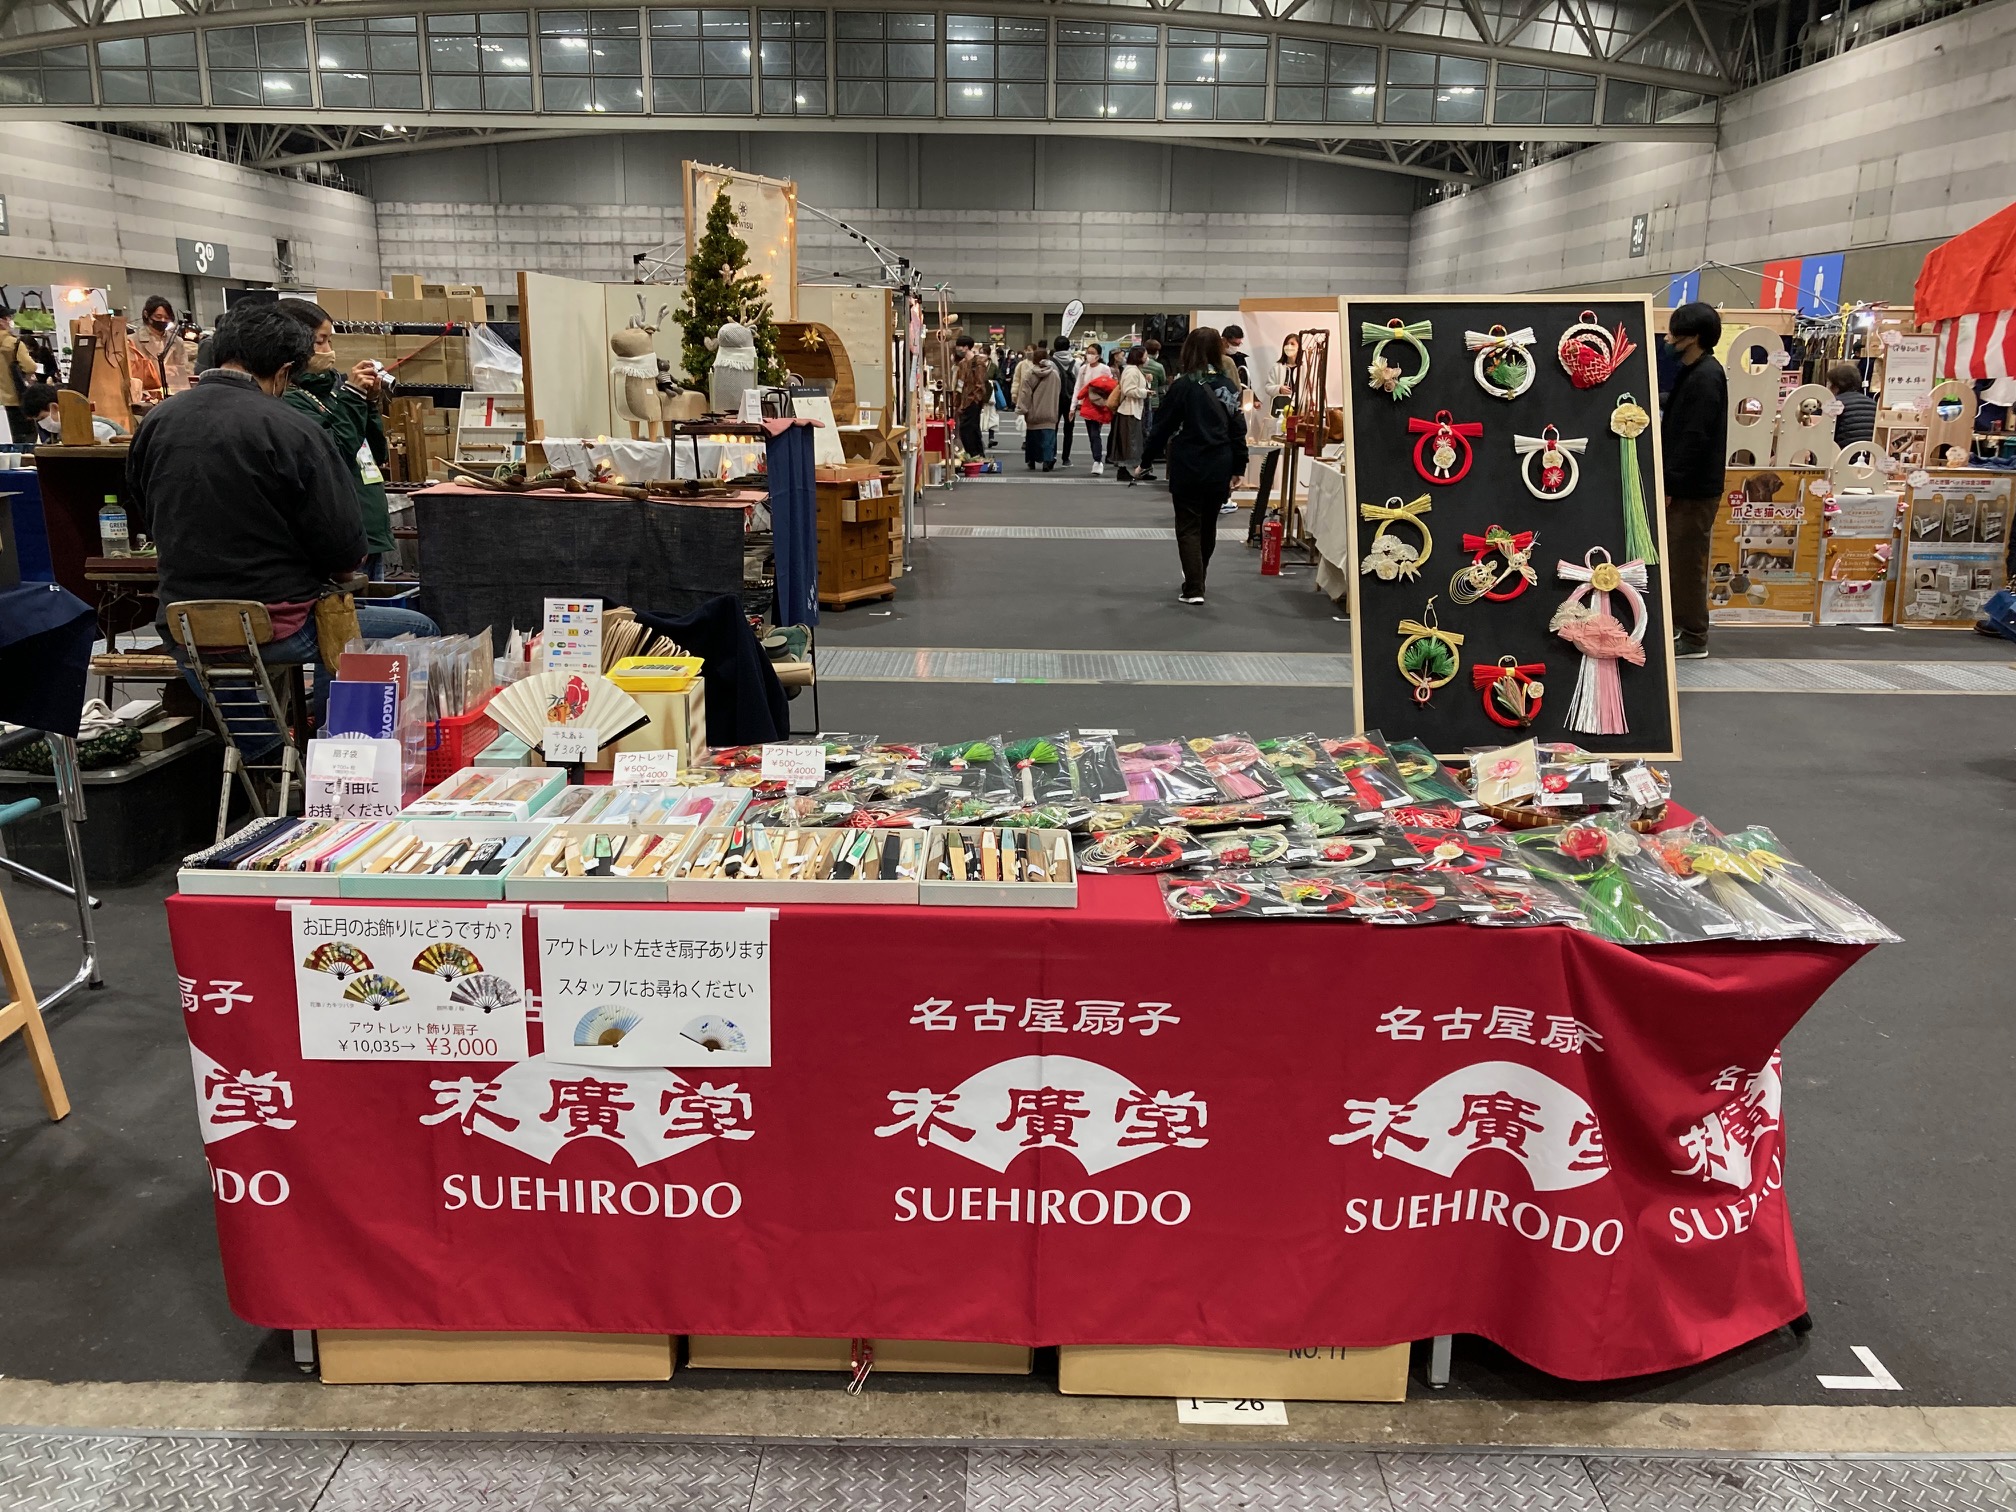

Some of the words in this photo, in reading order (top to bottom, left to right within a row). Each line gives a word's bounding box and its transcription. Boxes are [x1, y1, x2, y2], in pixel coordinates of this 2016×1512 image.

[1633, 219, 1644, 245] 北
[1732, 507, 1803, 518] 爪とぎ猫ベッド
[333, 750, 358, 764] 扇子袋
[618, 752, 674, 763] アウトレット
[766, 748, 822, 757] アウトレット
[640, 771, 668, 779] ¥4000
[788, 767, 817, 775] ¥4000
[303, 917, 512, 940] お正月のお飾りにどうですか？
[545, 938, 768, 959] アウトレット左きき扇子あります
[559, 978, 754, 999] スタッフにお尋ねください
[909, 996, 1180, 1036] 名古屋扇子
[349, 1022, 478, 1036] アウトレット飾り扇子
[426, 1037, 498, 1058] ¥3,000
[419, 1076, 755, 1141] 末廣堂
[874, 1086, 1209, 1149] 末廣堂
[442, 1173, 743, 1219] SUEHIRODO
[893, 1186, 1192, 1226] SUEHIRODO
[1343, 1188, 1625, 1256] SUEHIRODO
